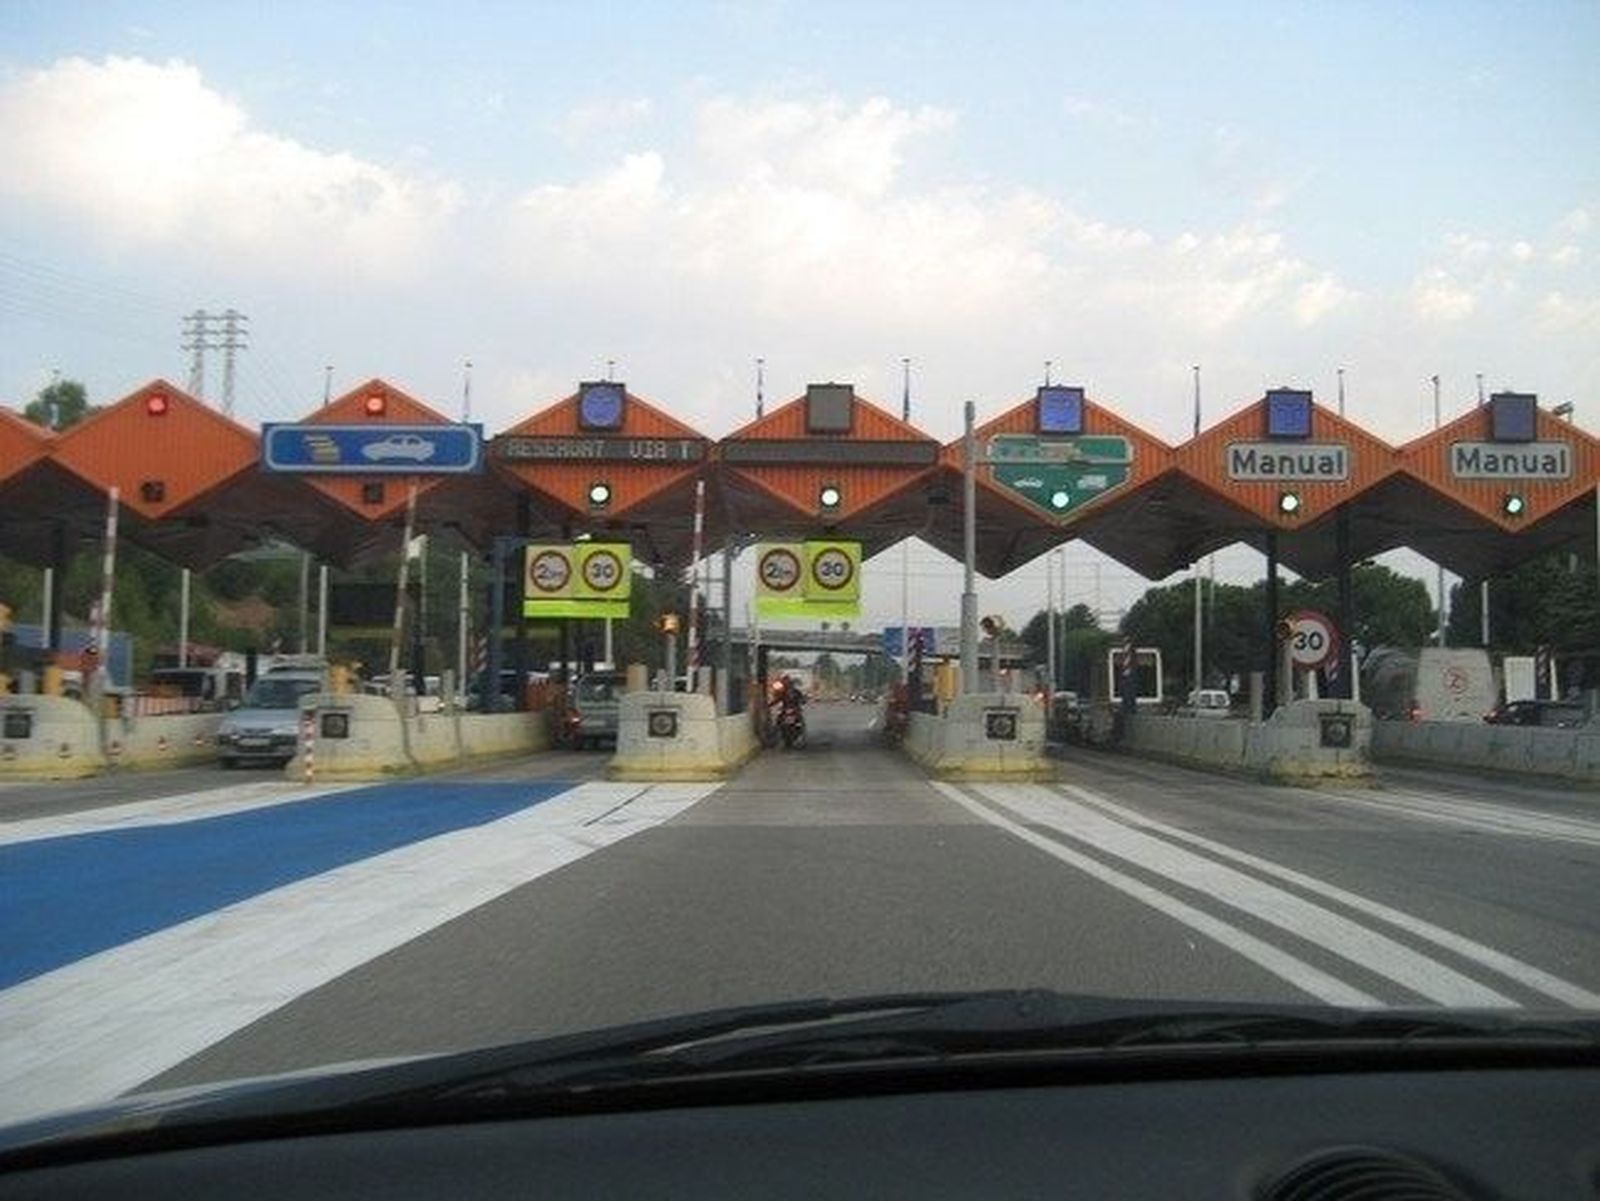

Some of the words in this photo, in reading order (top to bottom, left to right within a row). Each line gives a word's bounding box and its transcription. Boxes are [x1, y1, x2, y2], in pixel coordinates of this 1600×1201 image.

[680, 440, 690, 459] T
[1232, 449, 1344, 475] Manual
[1456, 448, 1567, 475] Manual
[1294, 631, 1324, 650] 30
